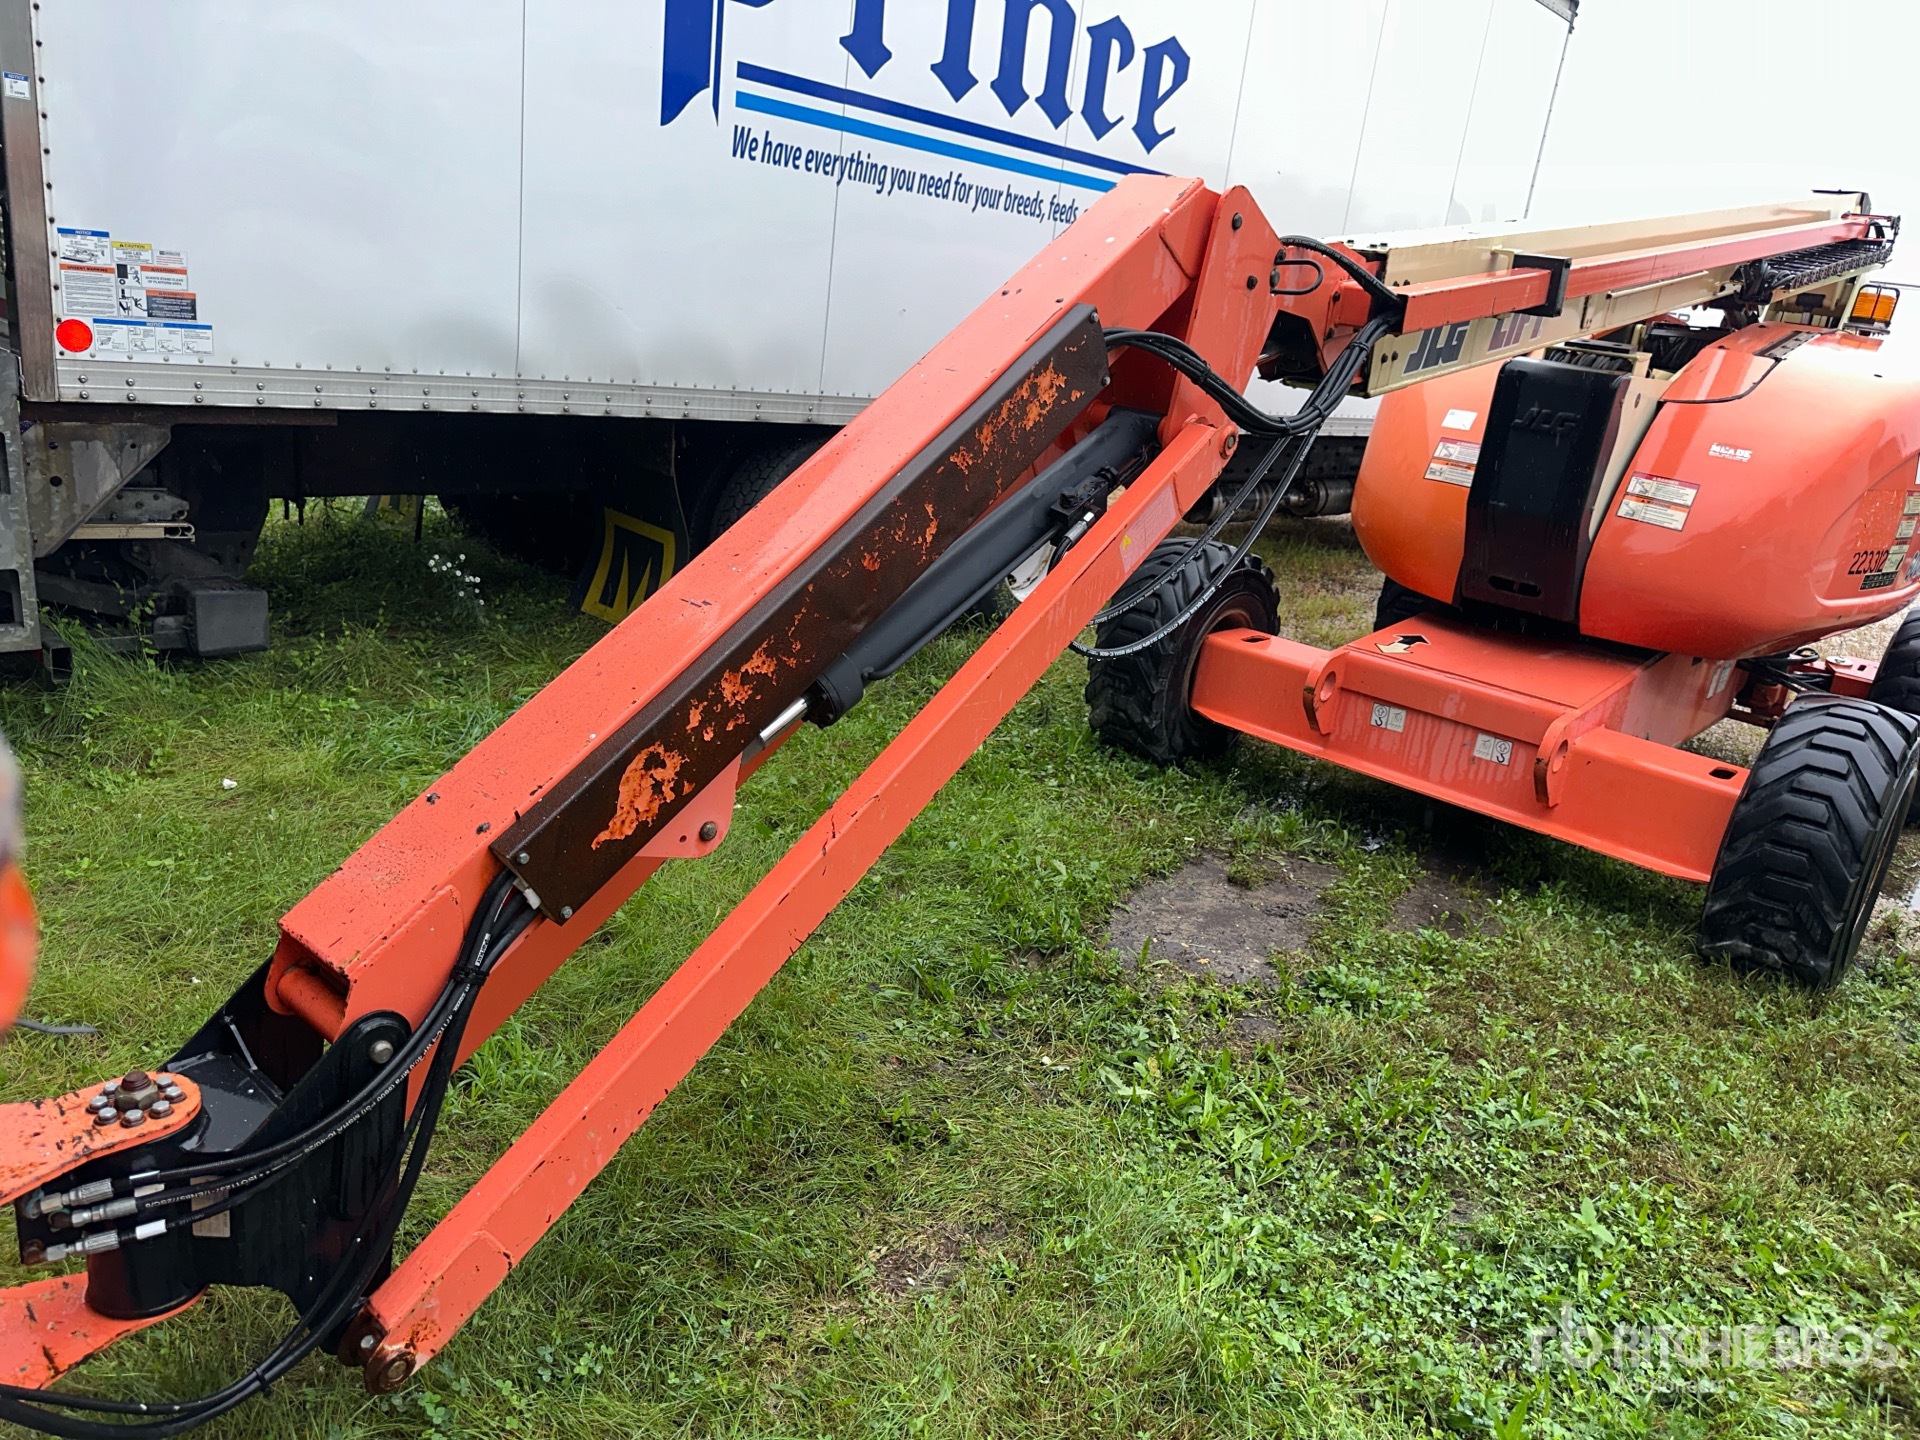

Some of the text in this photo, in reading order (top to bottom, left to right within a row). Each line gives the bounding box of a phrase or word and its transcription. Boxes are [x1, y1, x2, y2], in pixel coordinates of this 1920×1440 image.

[732, 125, 758, 161] We
[761, 130, 802, 170] have
[805, 149, 888, 194] everything
[887, 167, 916, 196] you
[917, 171, 953, 200] need
[952, 173, 973, 204] for
[972, 185, 1003, 213] your
[1004, 184, 1046, 223] breeds,
[1402, 320, 1471, 376] JLG
[1511, 407, 1580, 433] JLG
